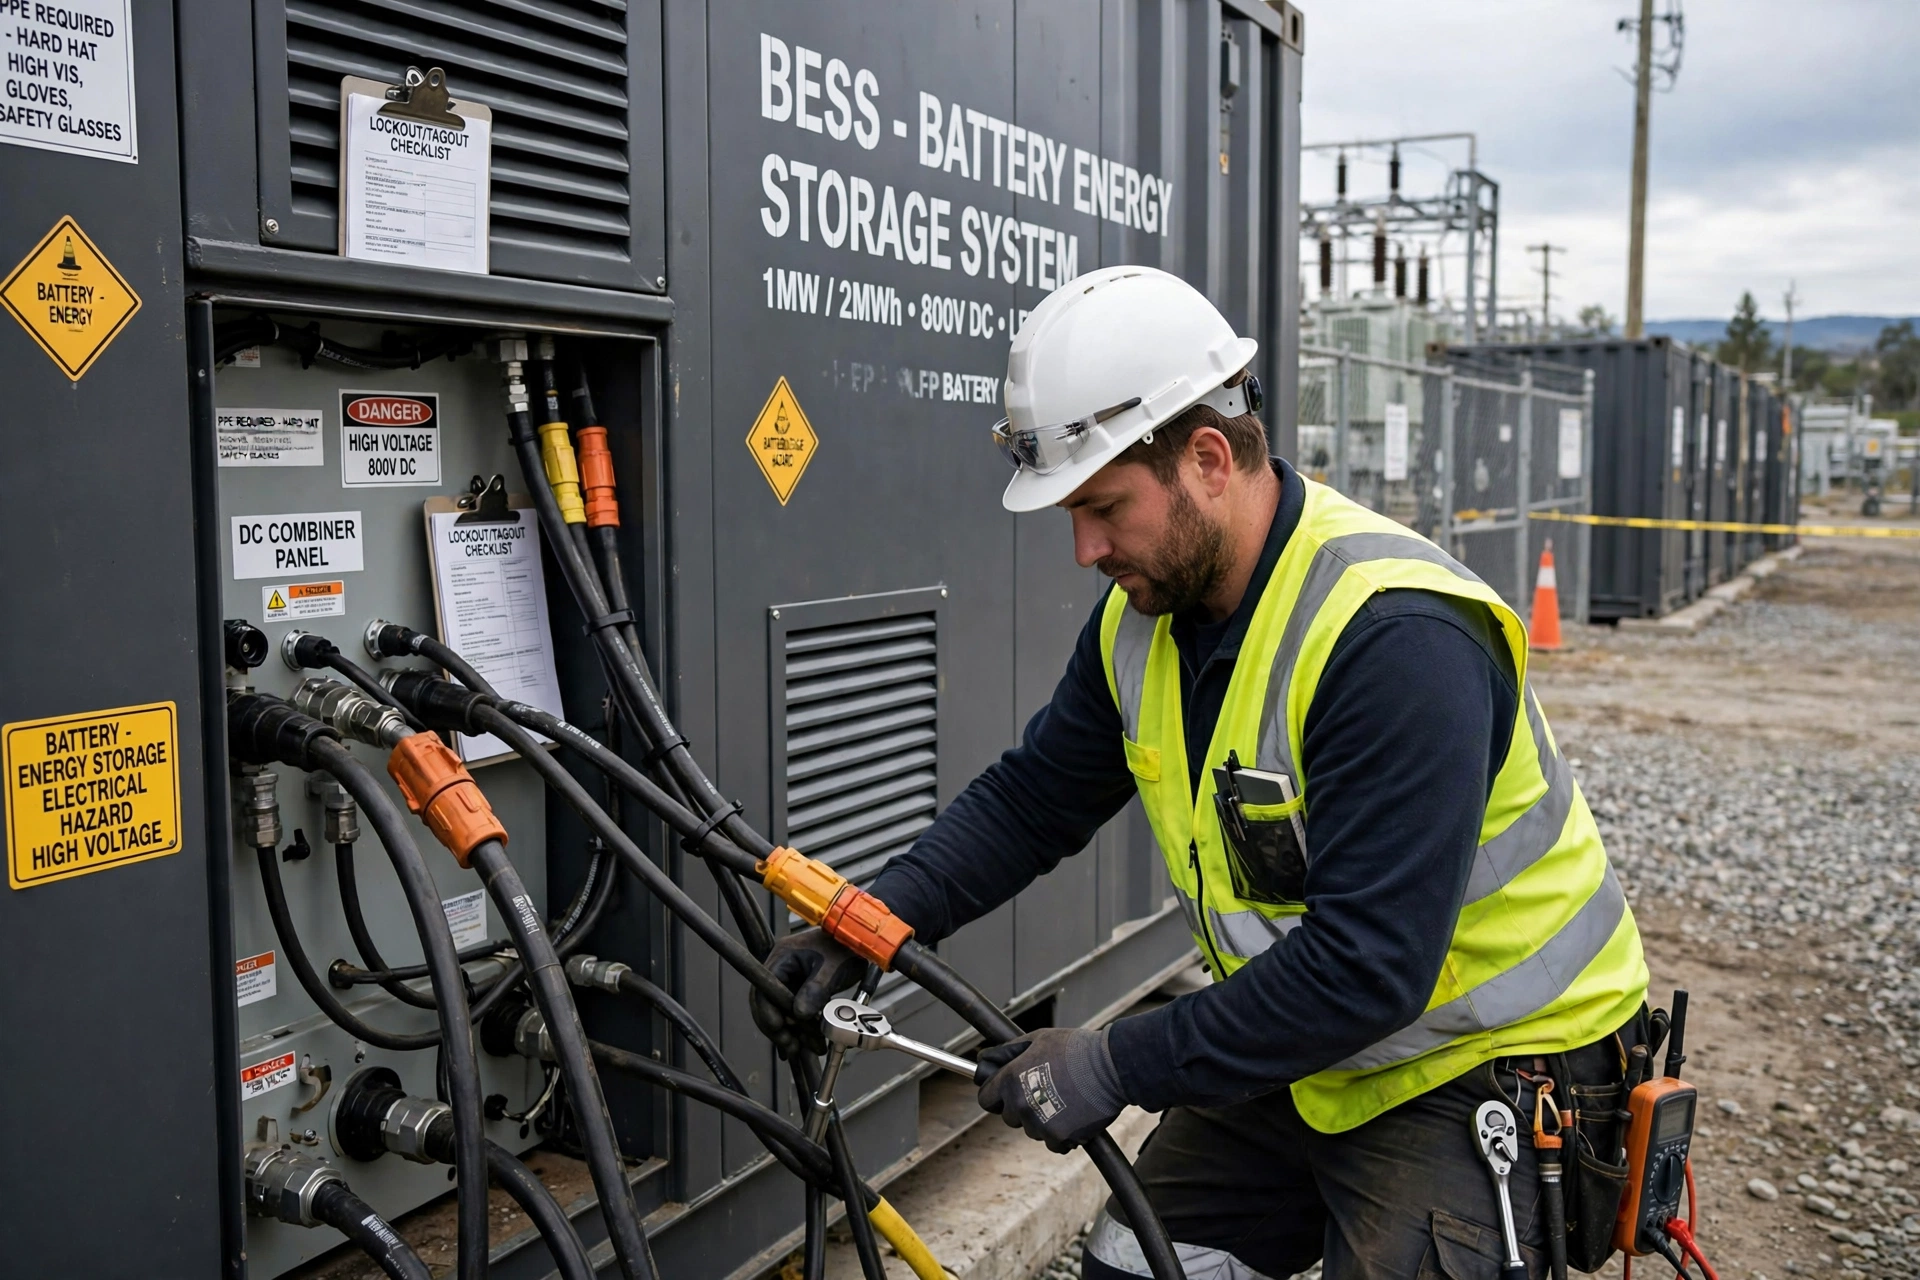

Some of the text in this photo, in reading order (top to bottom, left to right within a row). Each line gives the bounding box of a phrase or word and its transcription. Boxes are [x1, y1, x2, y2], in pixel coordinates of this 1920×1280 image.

[0, 0, 114, 38] PPE REQUIRED
[17, 26, 63, 53] HARD
[68, 37, 98, 61] HAT
[8, 52, 84, 88] HIGH VIS,
[6, 79, 72, 111] GLOVES,
[0, 103, 122, 141] SAFETY GLASSES
[369, 116, 469, 148] LOCKOUT/TAGOUT
[760, 32, 1173, 238] BESS - BATTERY ENERGY
[390, 137, 451, 160] CHECKLIST
[760, 153, 1078, 292] STORAGE SYSTEM
[37, 282, 94, 304] BATTERY
[763, 267, 820, 315] 1MW
[825, 277, 835, 317] /
[839, 280, 902, 327] 2MWh
[921, 293, 966, 335] 800V
[969, 301, 994, 340] DC
[49, 305, 93, 326] ENERGY
[358, 402, 422, 421] DANGER
[349, 433, 433, 452] HIGH VOLTAGE
[368, 457, 416, 476] 800V DC
[239, 519, 356, 545] DC COMBINER
[448, 526, 526, 544] LOCKOUT/TAGOUT
[275, 546, 329, 569] PANEL
[465, 541, 513, 557] CHECKLIST
[45, 722, 120, 756] BATTERY
[18, 741, 167, 789] ENERGY STORAGE
[43, 772, 147, 812] ELECTRICAL
[60, 801, 133, 836] HAZARD
[32, 820, 163, 871] HIGH VOLTAGE
